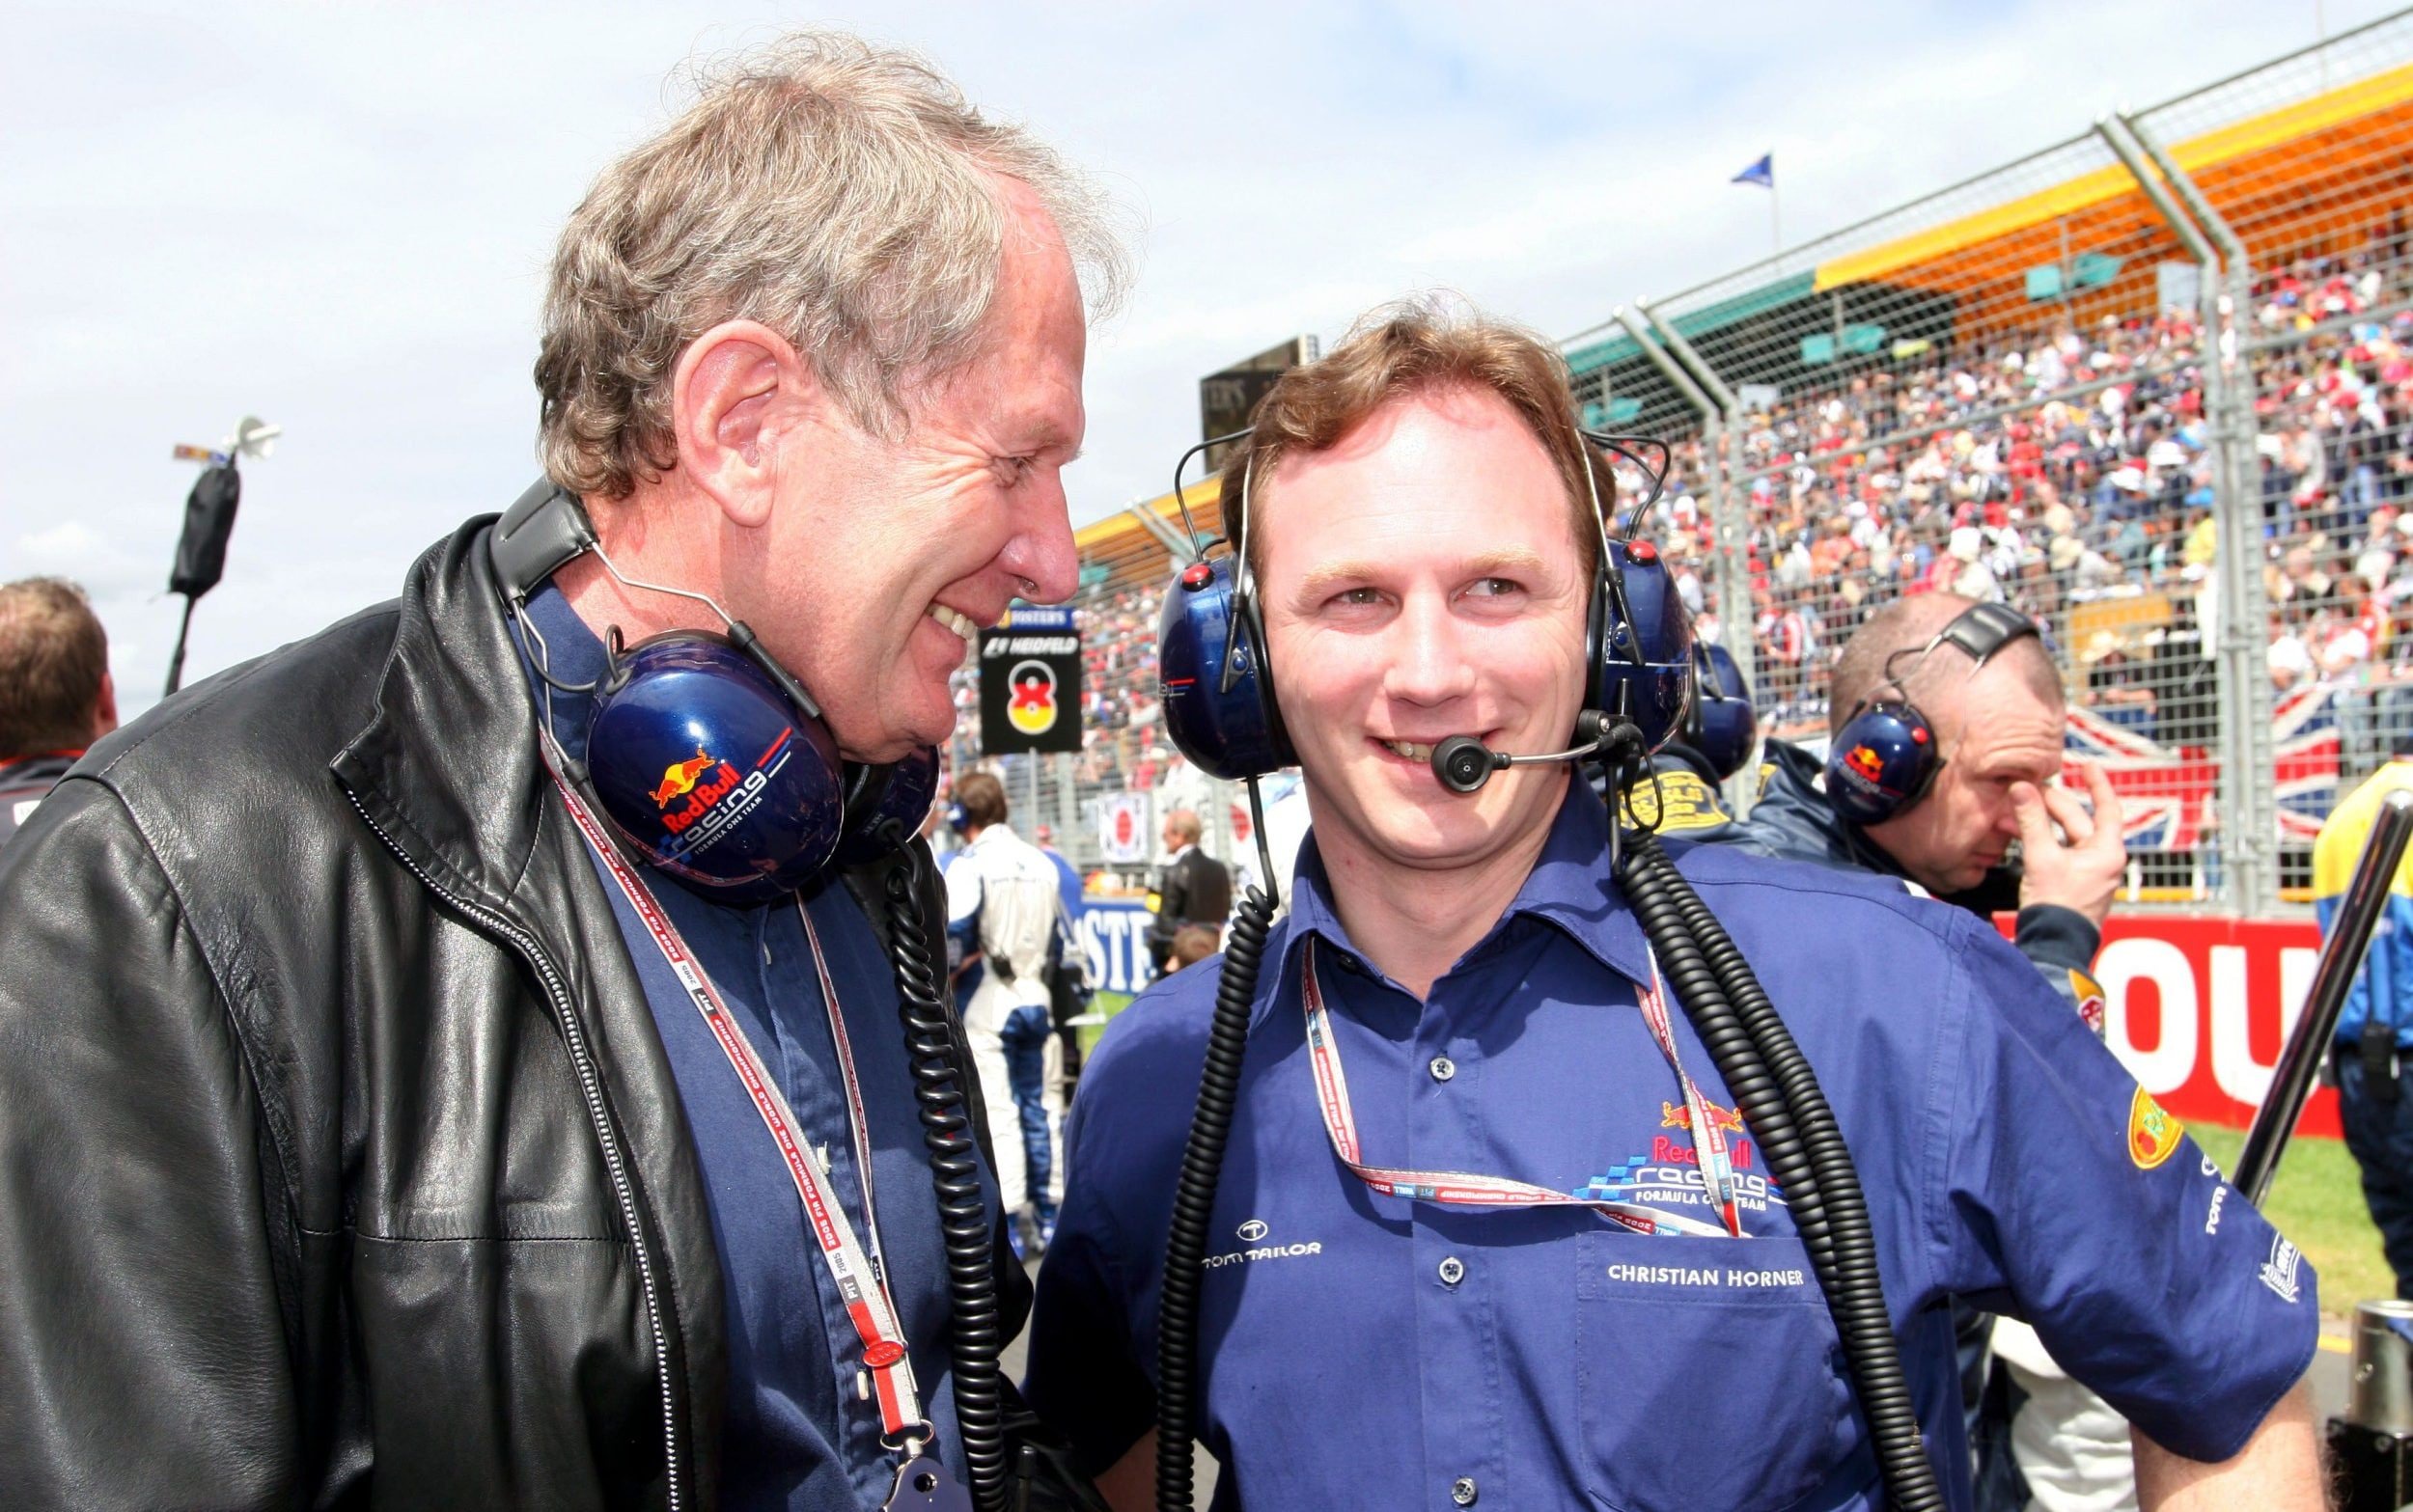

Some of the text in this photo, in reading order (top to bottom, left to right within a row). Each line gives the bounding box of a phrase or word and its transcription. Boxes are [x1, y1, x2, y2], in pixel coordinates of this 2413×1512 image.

[1007, 660, 1058, 735] 8
[672, 771, 767, 852] racing
[727, 814, 743, 830] ONE
[741, 796, 763, 815] TEAM
[581, 817, 606, 849] WORLD
[605, 850, 621, 868] ONE
[619, 870, 652, 915] FORMULA
[698, 994, 714, 1011] PIT
[714, 1019, 837, 1248] 2005 FIA FORMULA ONE WORLD CHAMPIONSHIP
[1635, 1168, 1766, 1197] racng
[1635, 1191, 1698, 1205] FORMULA
[1245, 1242, 1321, 1260] TAILOR
[833, 1252, 859, 1300] PIT 2005
[1608, 1265, 1804, 1287] CHRISTIAN HORNER
